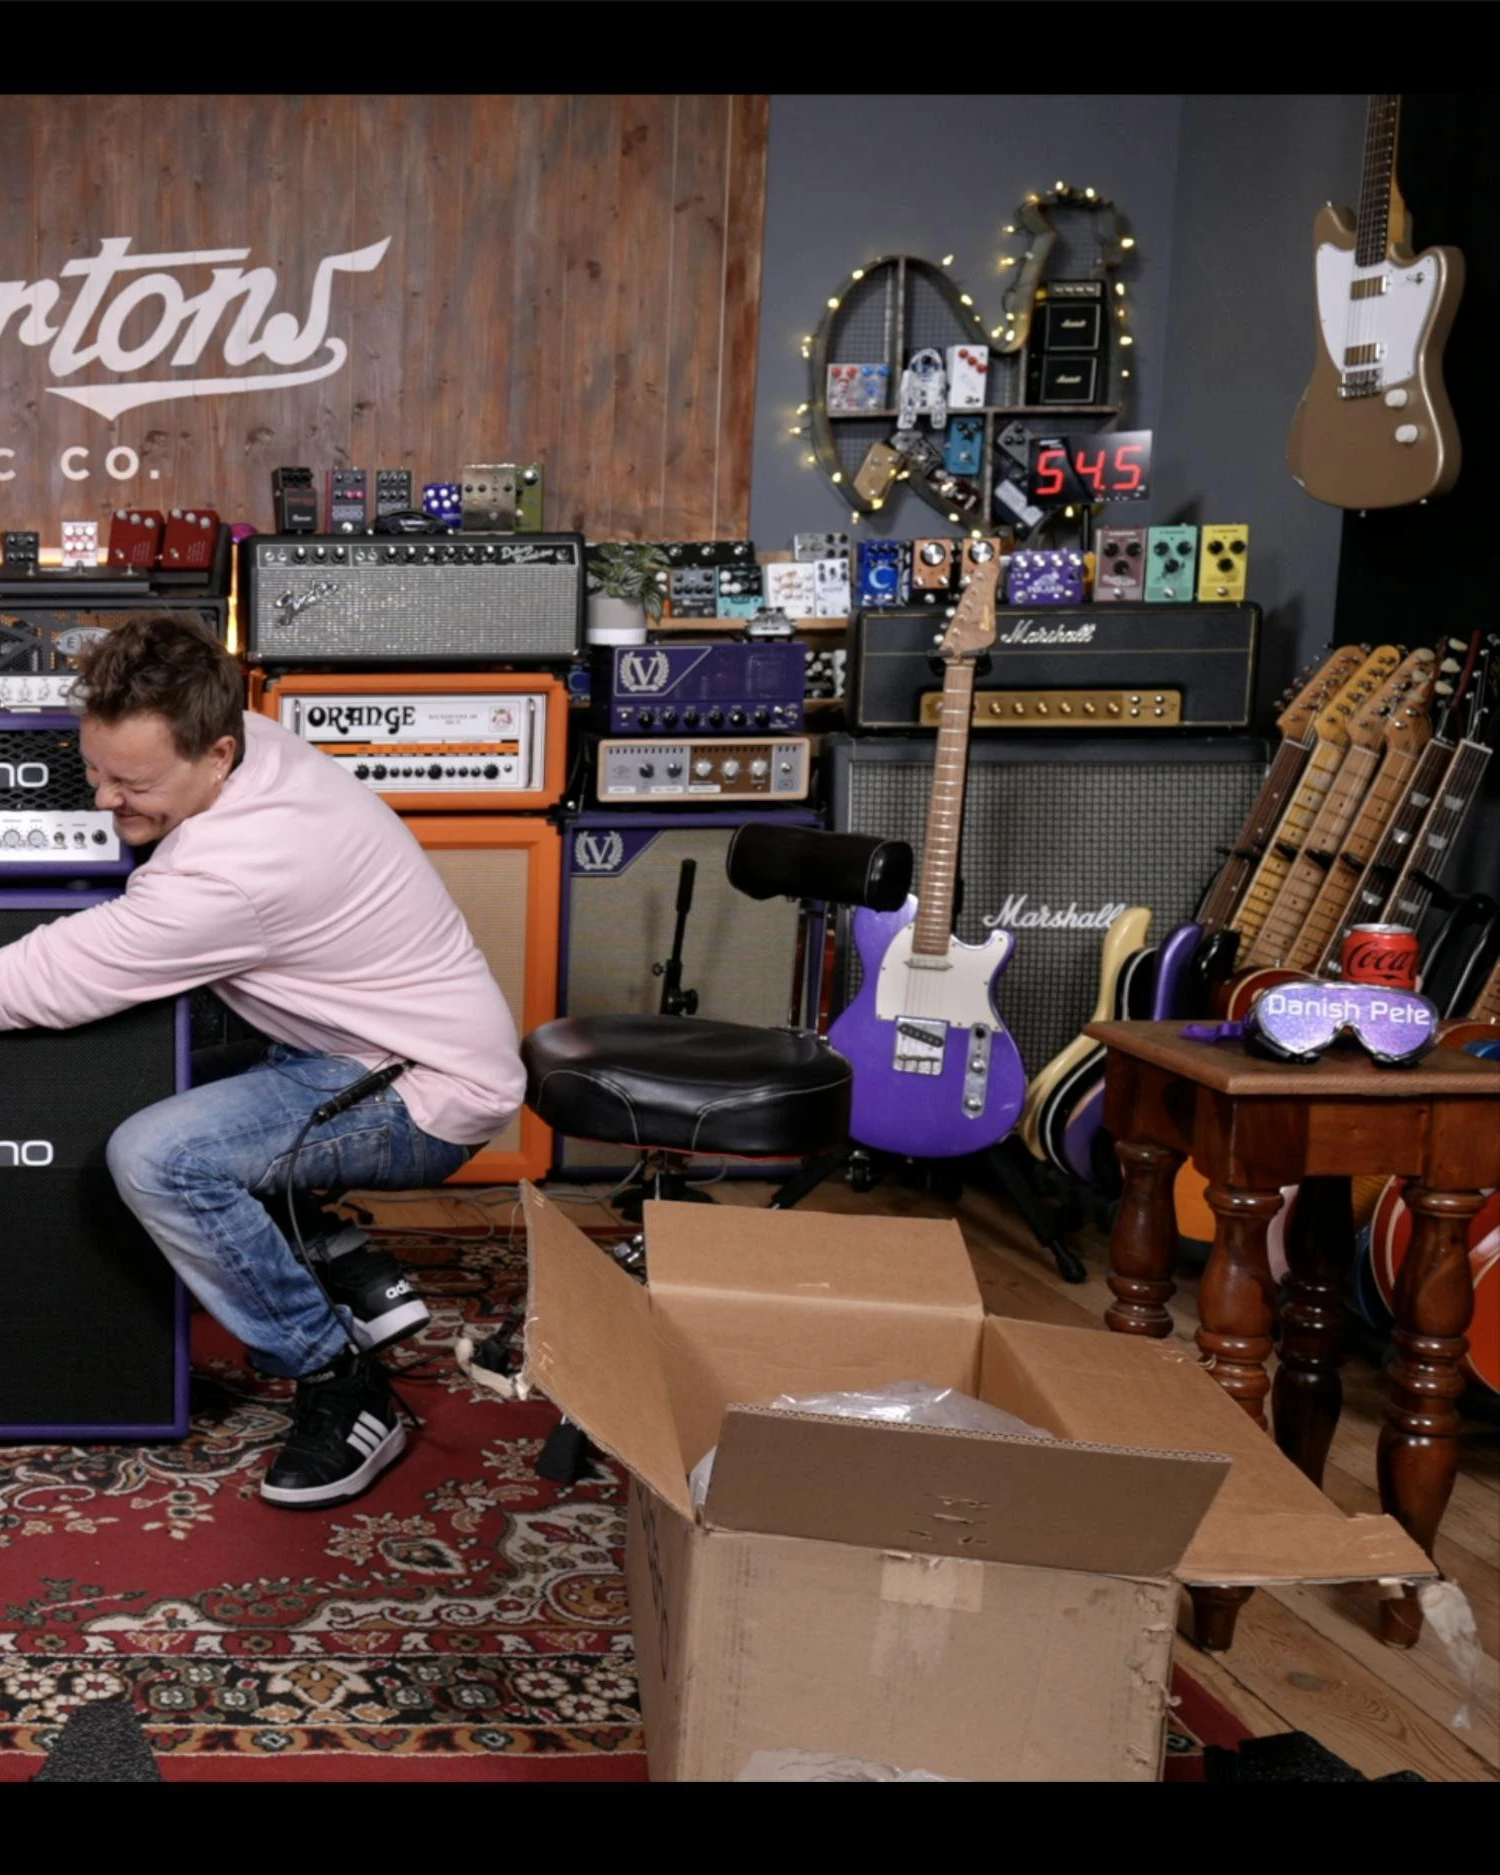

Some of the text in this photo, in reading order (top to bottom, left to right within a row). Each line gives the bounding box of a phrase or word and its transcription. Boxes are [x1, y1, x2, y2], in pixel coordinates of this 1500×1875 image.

[60, 445, 161, 482] CO.
[1001, 620, 1096, 644] Marshall
[307, 706, 416, 735] ORANGE
[982, 894, 1126, 929] Marshall
[1267, 993, 1431, 1025] Danish Pete
